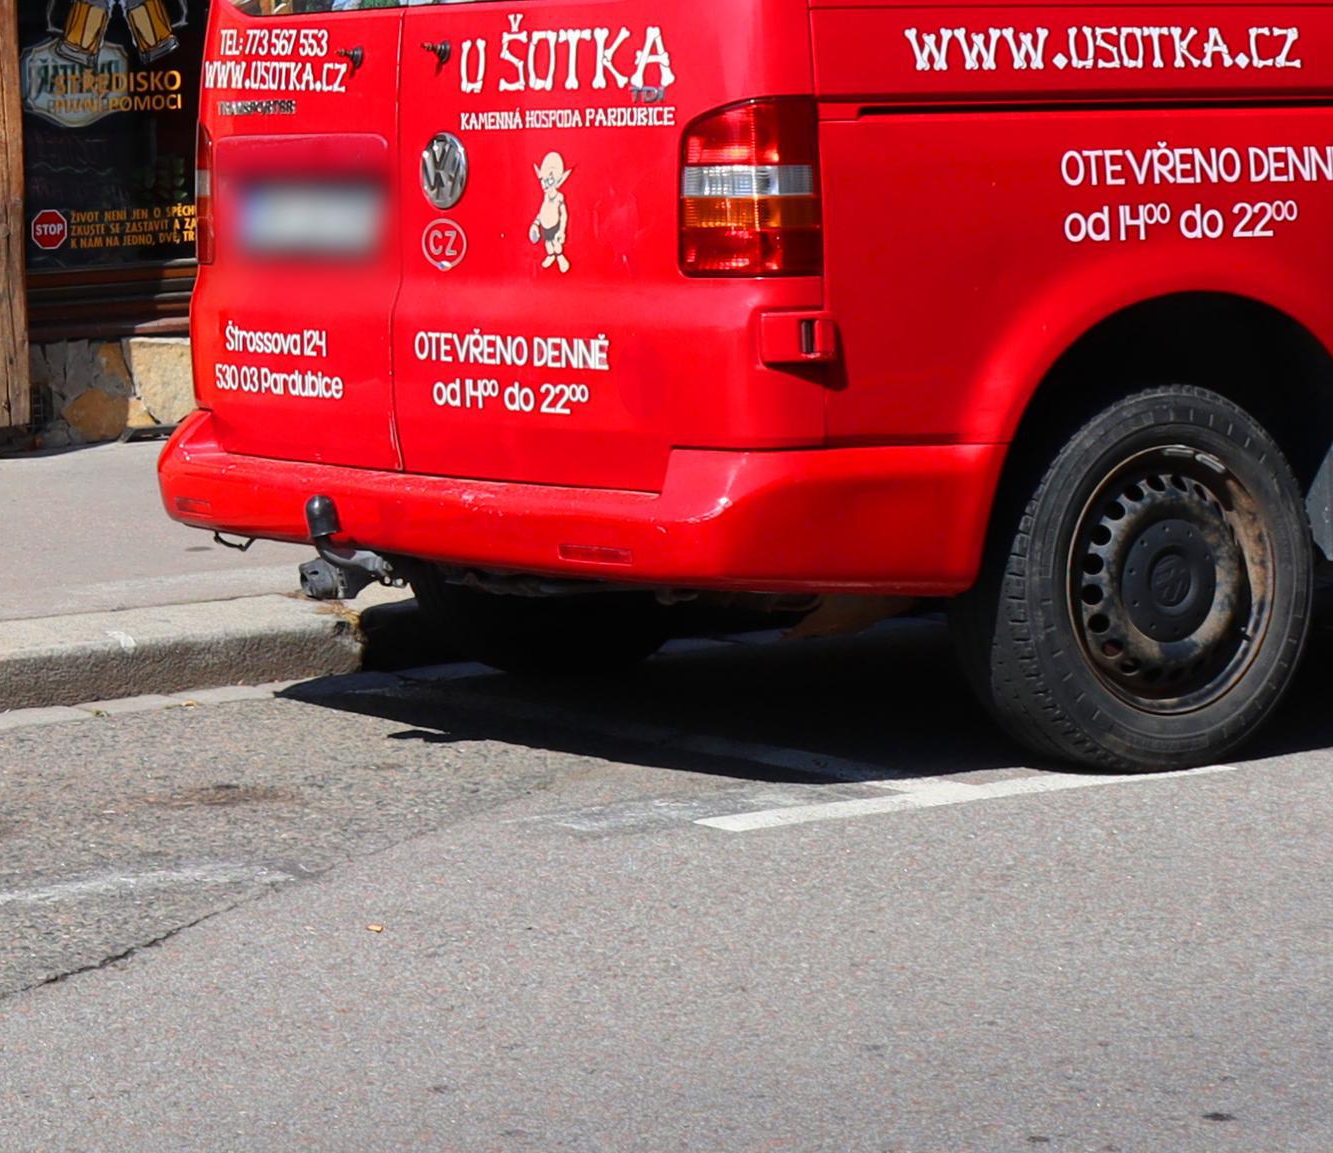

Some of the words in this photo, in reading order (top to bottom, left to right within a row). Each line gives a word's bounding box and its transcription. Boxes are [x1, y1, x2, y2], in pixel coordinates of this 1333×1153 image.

[220, 29, 244, 56] TEL:
[245, 29, 269, 55] 773
[271, 29, 297, 56] 567
[299, 29, 328, 57] 553
[460, 38, 486, 93] U
[498, 13, 676, 92] ŠOTKA
[903, 26, 1302, 71] WWW.USOTKA.CZ
[205, 60, 347, 93] WWW.USOTKA.CZ
[629, 86, 667, 103] TDI
[460, 108, 523, 131] KAMENNÁ
[525, 109, 582, 129] HOSPODA
[585, 106, 676, 127] PARDUBICE
[1061, 141, 1242, 186] OTEVŘENO
[1248, 146, 1333, 182] DENN
[166, 202, 196, 217] SPĚCH
[1064, 206, 1110, 242] od
[1180, 203, 1224, 239] do
[35, 223, 64, 236] STOP
[429, 229, 458, 257] CZ
[225, 320, 301, 356] Štrossova
[303, 329, 327, 357] 124
[414, 328, 528, 367] OTEVŘENO
[533, 333, 609, 370] DENNĚ
[215, 363, 238, 390] 530
[240, 366, 259, 393] 03
[261, 367, 343, 399] Pardubice
[433, 378, 461, 407] od
[504, 382, 535, 412] do
